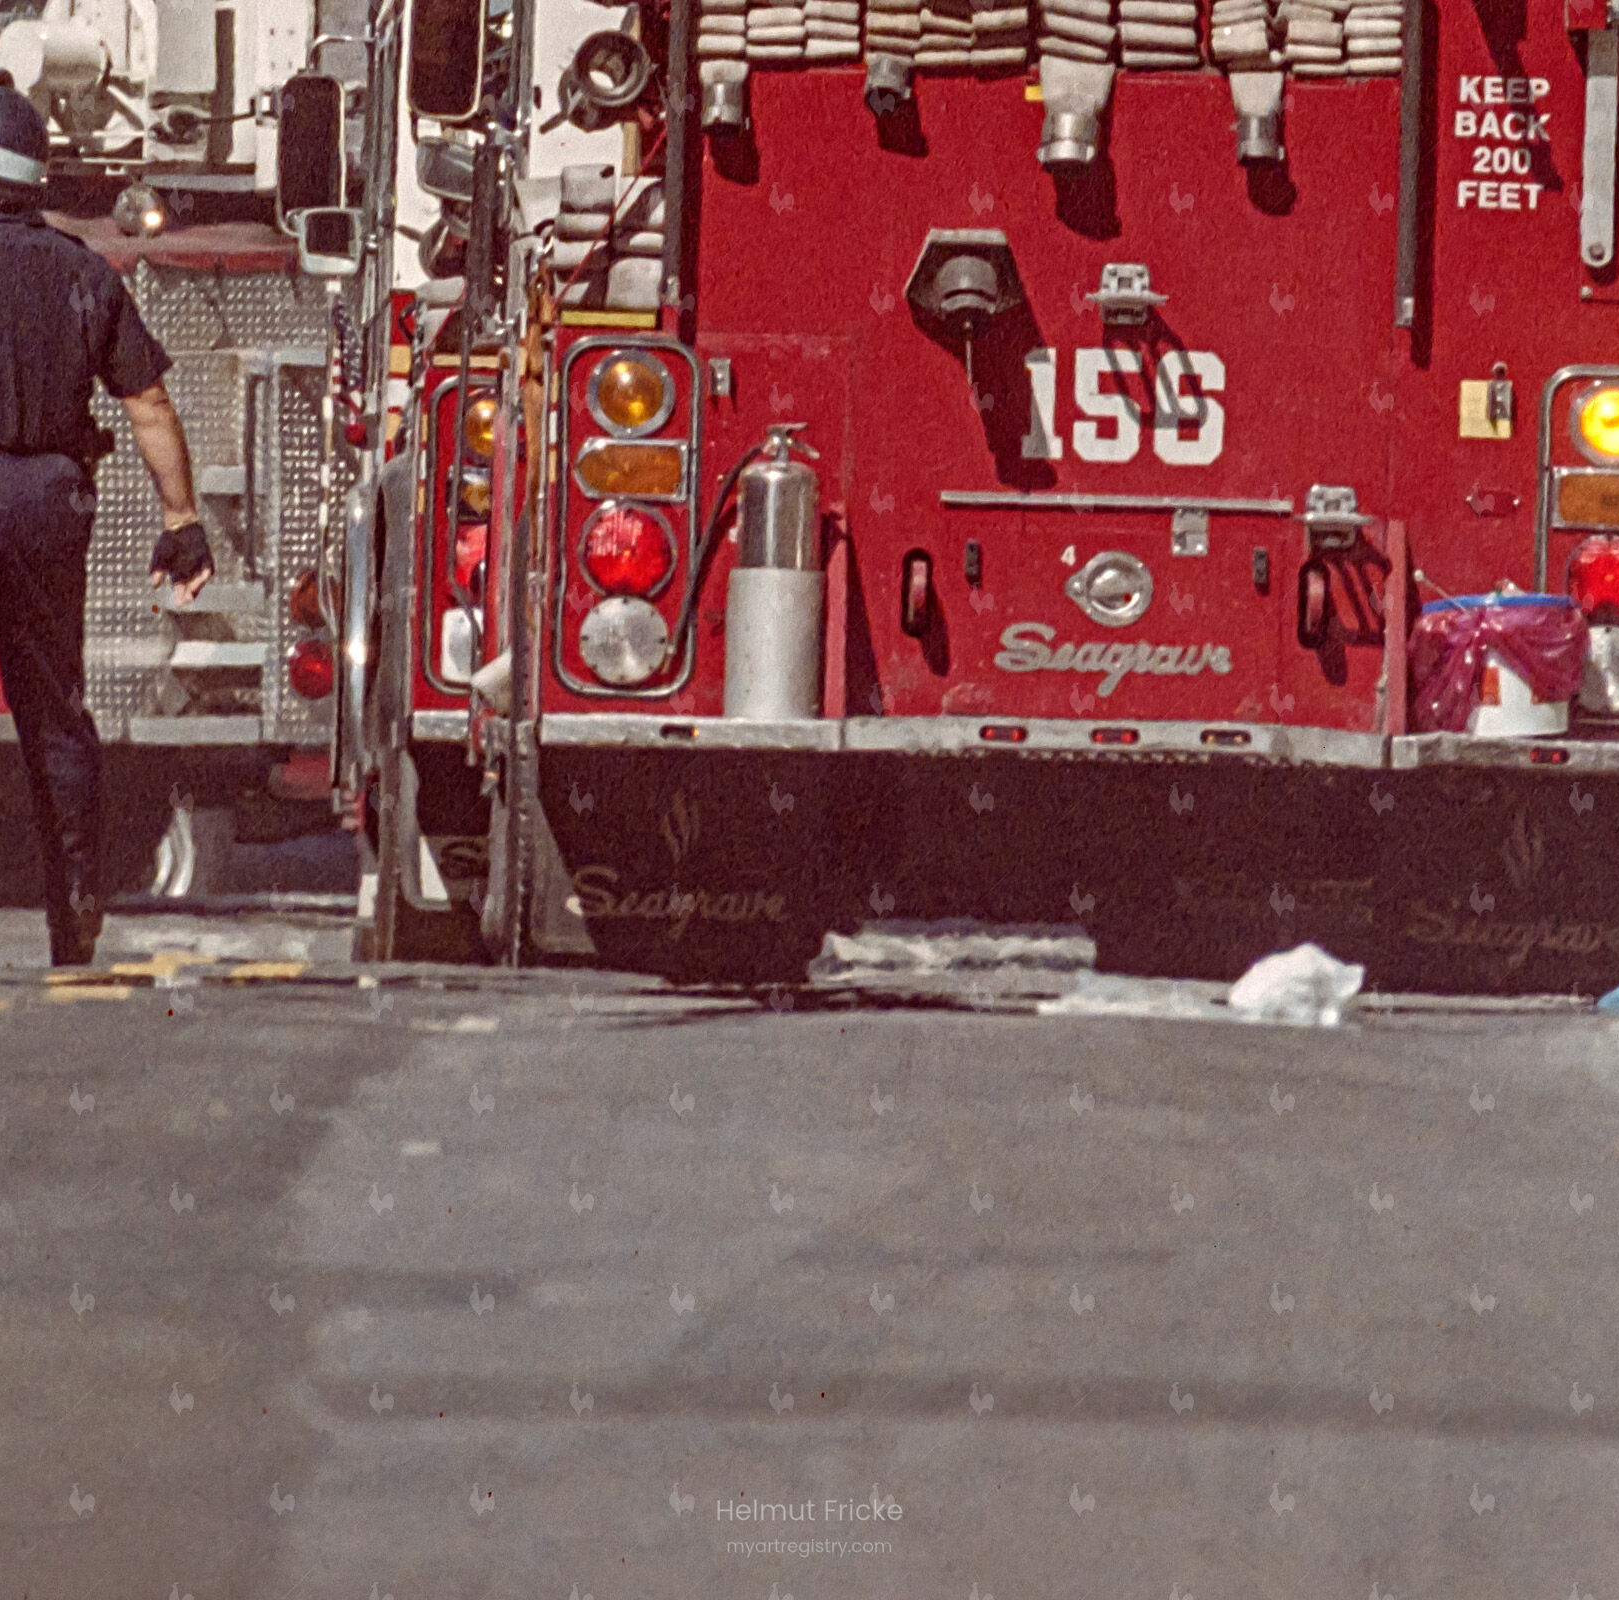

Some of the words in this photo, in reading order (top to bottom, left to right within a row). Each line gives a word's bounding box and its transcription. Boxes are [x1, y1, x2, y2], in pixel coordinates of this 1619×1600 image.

[1459, 75, 1550, 104] KEEP
[1454, 110, 1551, 142] BACK
[1473, 146, 1531, 175] 200
[1457, 180, 1544, 211] FEET
[1021, 347, 1226, 466] 156
[994, 621, 1234, 698] Seagrave
